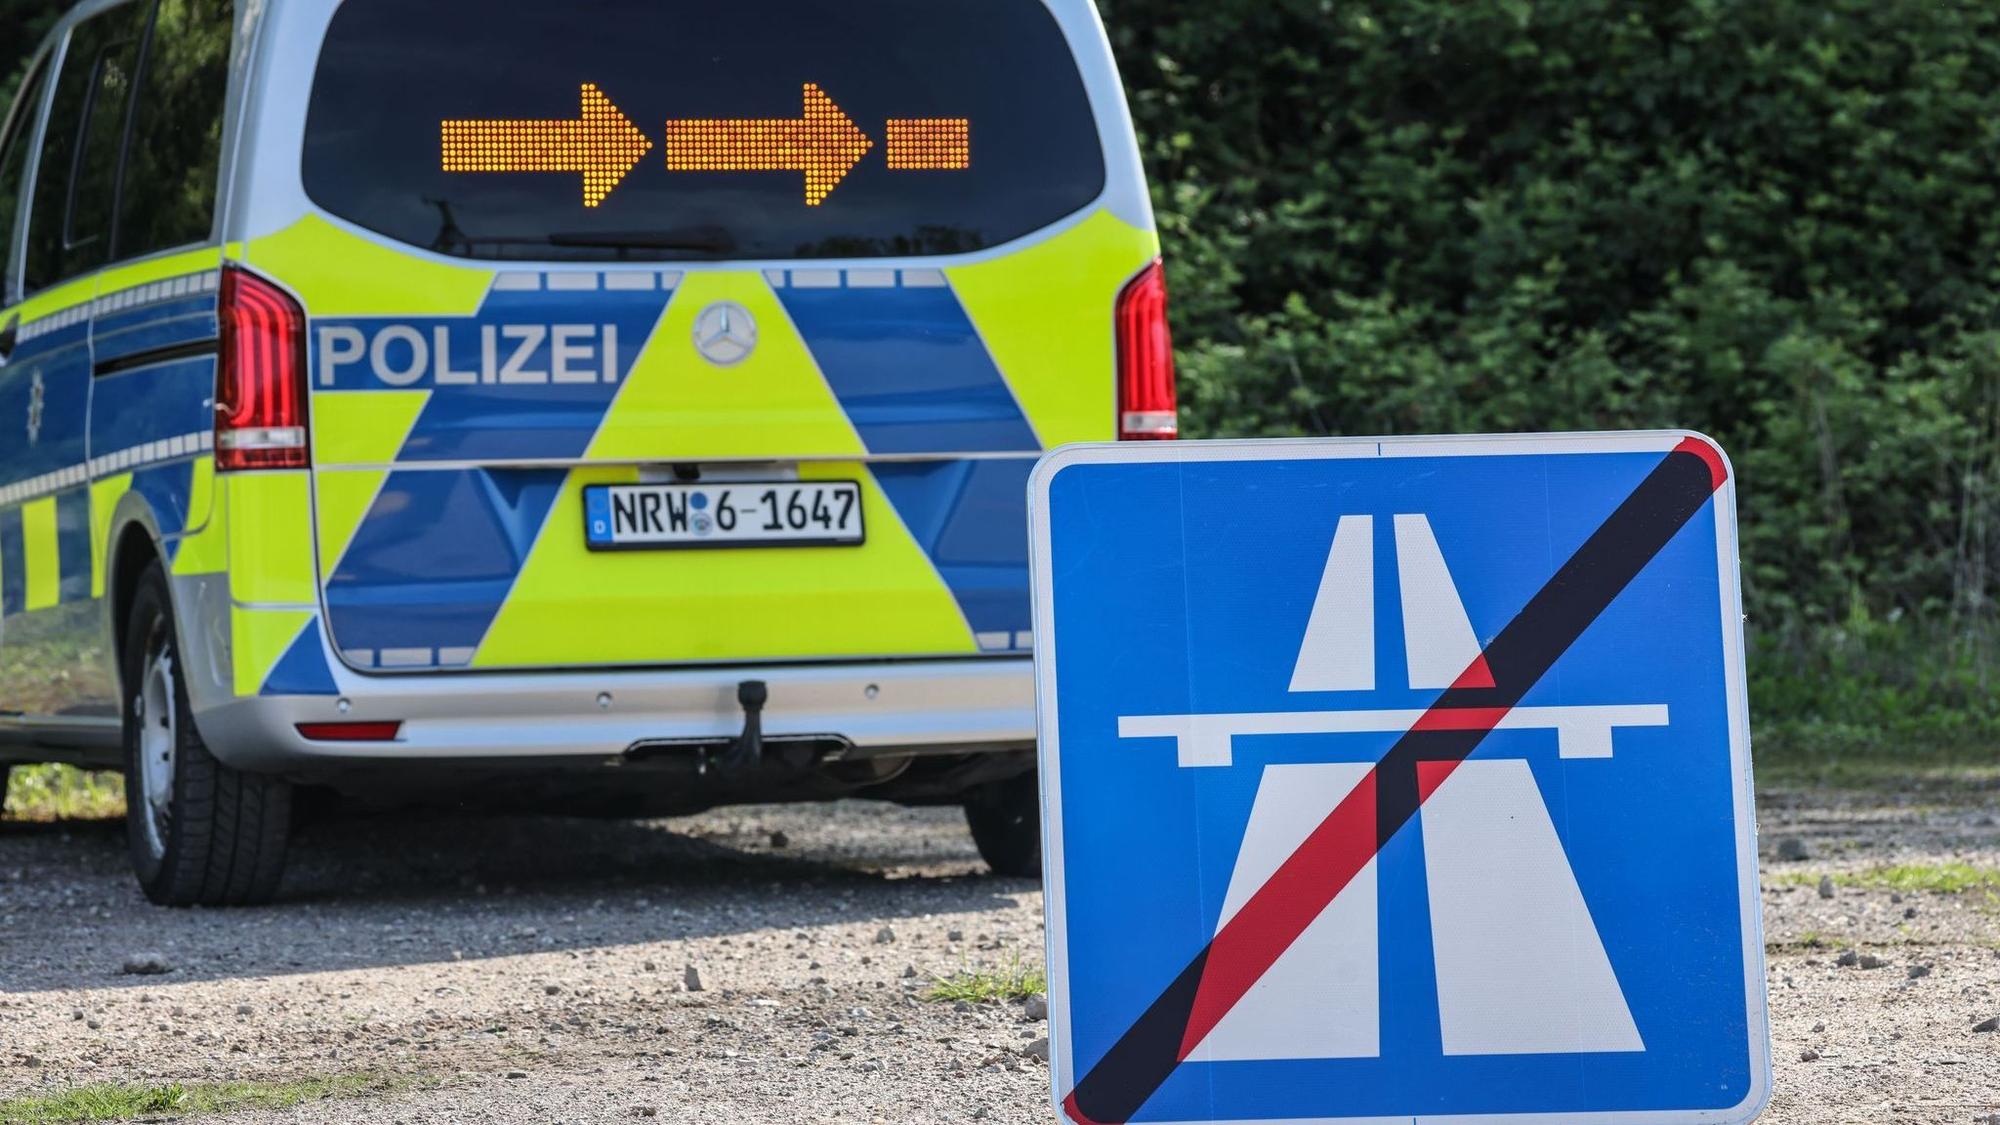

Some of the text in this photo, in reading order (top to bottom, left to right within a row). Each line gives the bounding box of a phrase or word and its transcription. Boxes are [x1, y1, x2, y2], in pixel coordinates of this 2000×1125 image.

[318, 324, 618, 386] POLIZEI
[613, 489, 855, 533] NRW 6-1647
